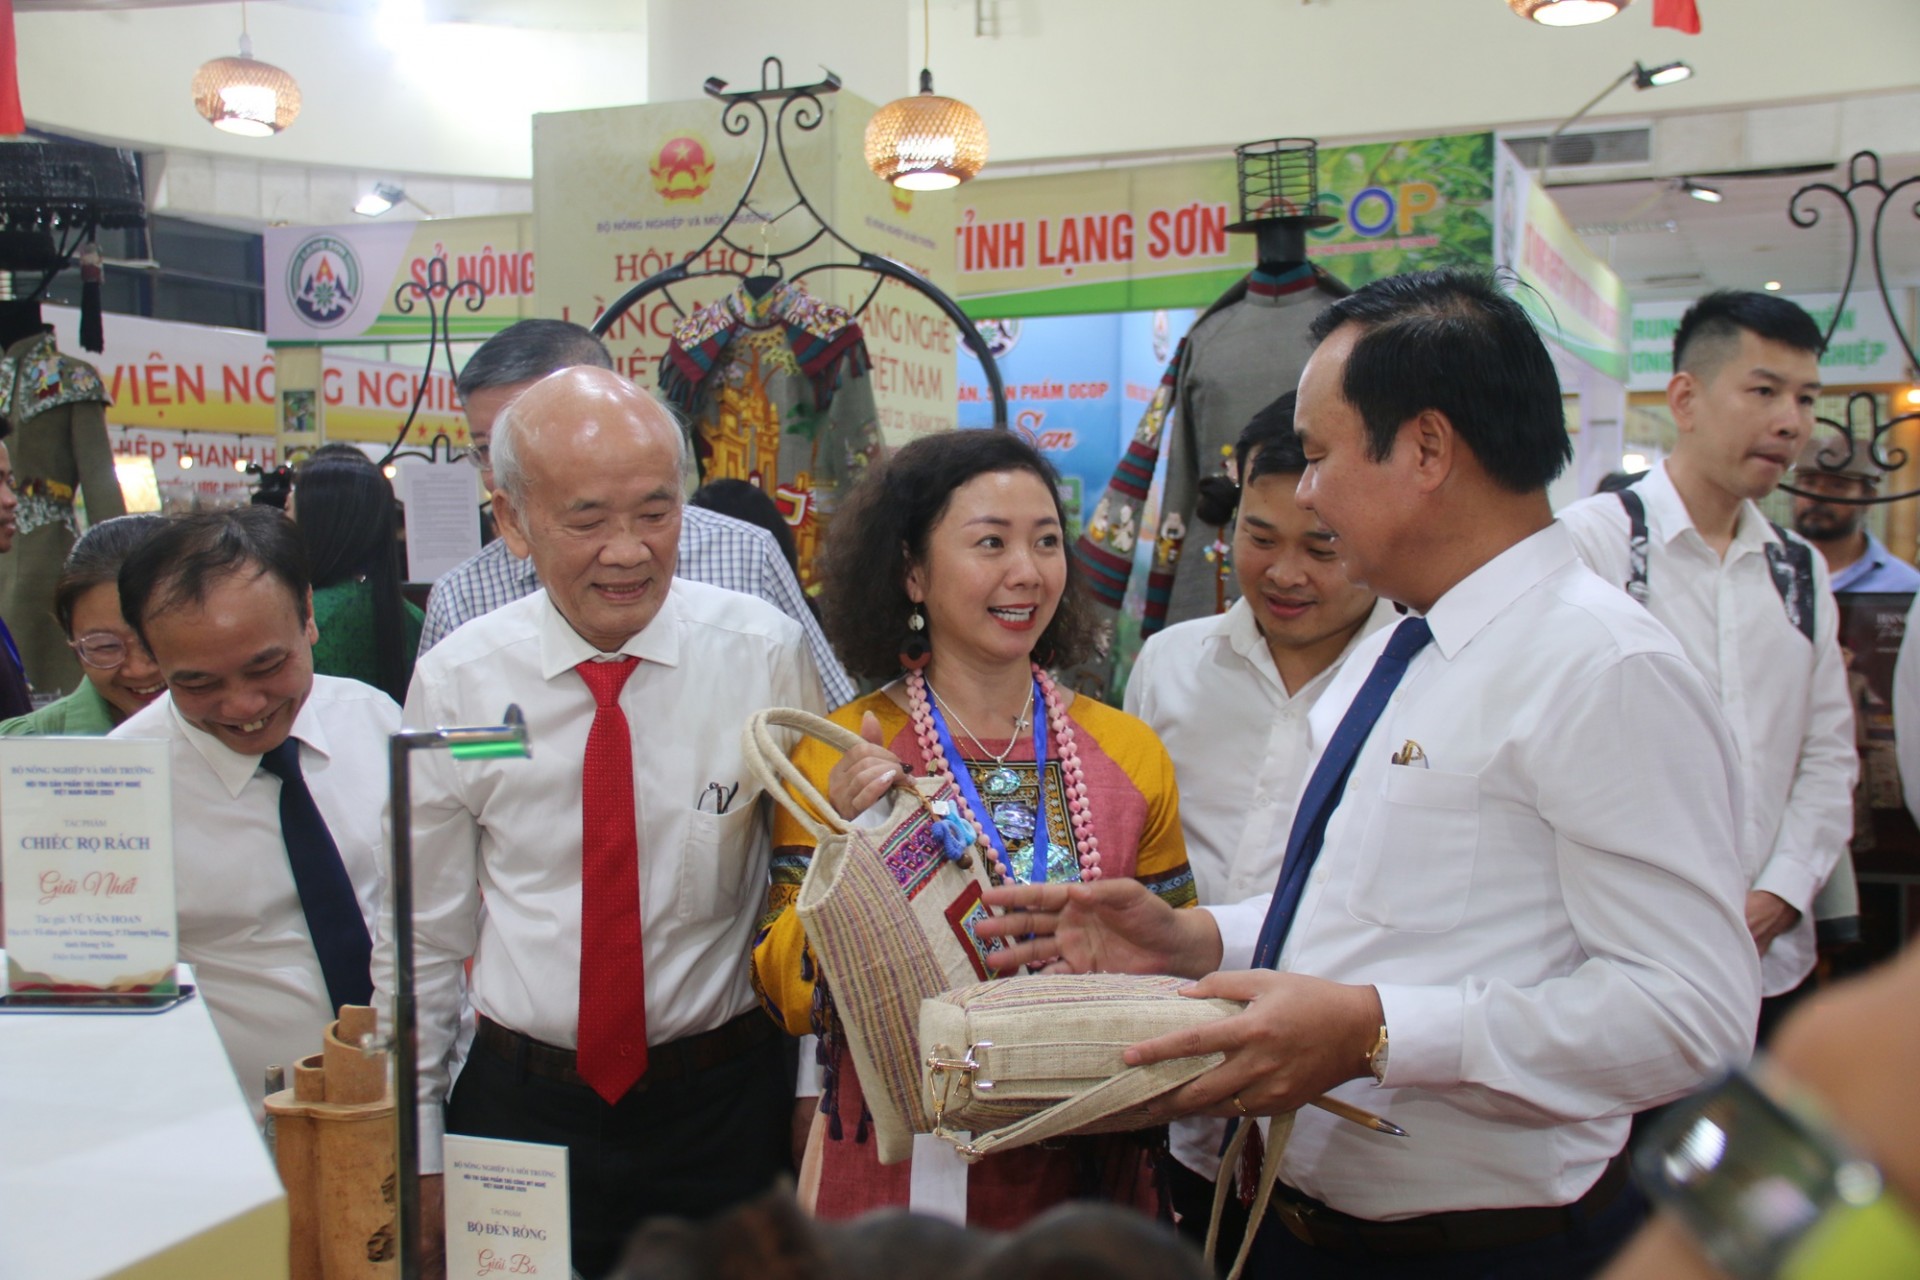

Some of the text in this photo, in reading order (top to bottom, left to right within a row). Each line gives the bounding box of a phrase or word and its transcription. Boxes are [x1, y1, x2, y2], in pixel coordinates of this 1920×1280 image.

[955, 209, 1024, 271] ỈNH
[1038, 213, 1134, 275] LẠNG
[1147, 203, 1226, 259] SƠN
[457, 246, 535, 299] NÔNG
[903, 360, 943, 402] NAM
[1068, 382, 1109, 399] OCOP
[21, 833, 150, 853] CHIẾC RỌ RÁCH
[38, 870, 79, 905] Giải
[467, 1220, 484, 1236] BỘ
[509, 1253, 538, 1275] Ba
